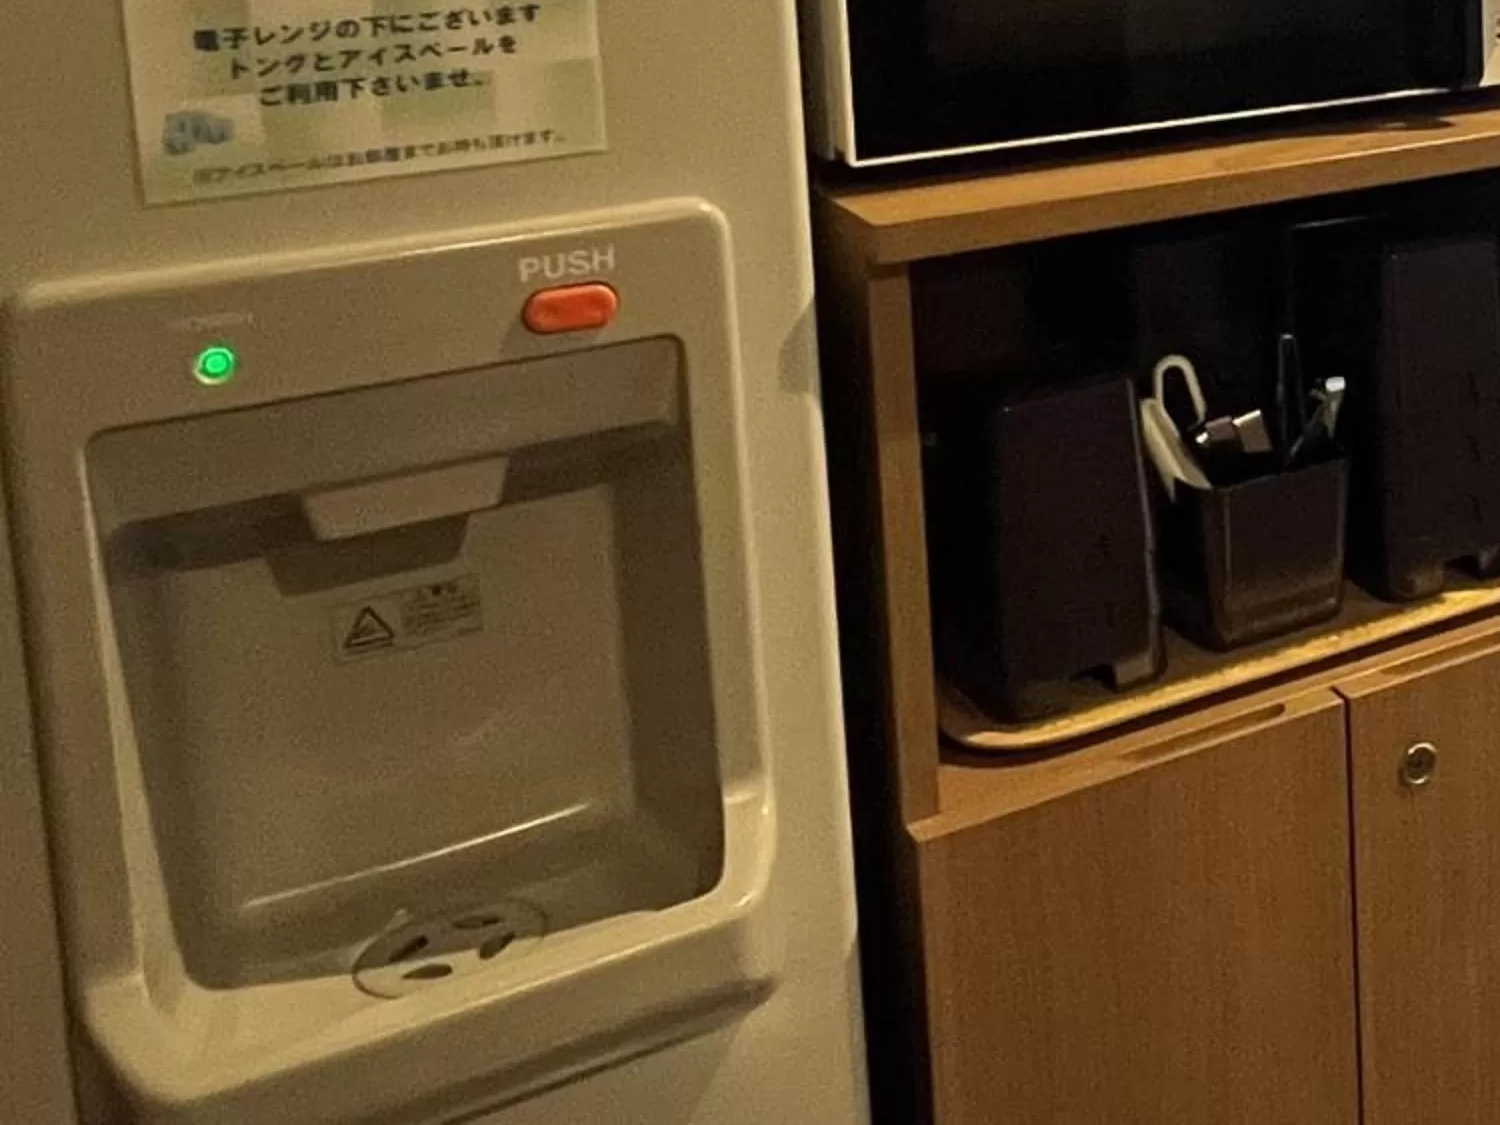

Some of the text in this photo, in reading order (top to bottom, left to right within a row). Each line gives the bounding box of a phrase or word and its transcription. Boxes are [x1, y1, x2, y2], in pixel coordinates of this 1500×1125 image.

[193, 3, 541, 52] 電子レンジの下にございます
[260, 68, 486, 107] ご利用下さいませ。
[517, 242, 615, 284] PUSH
